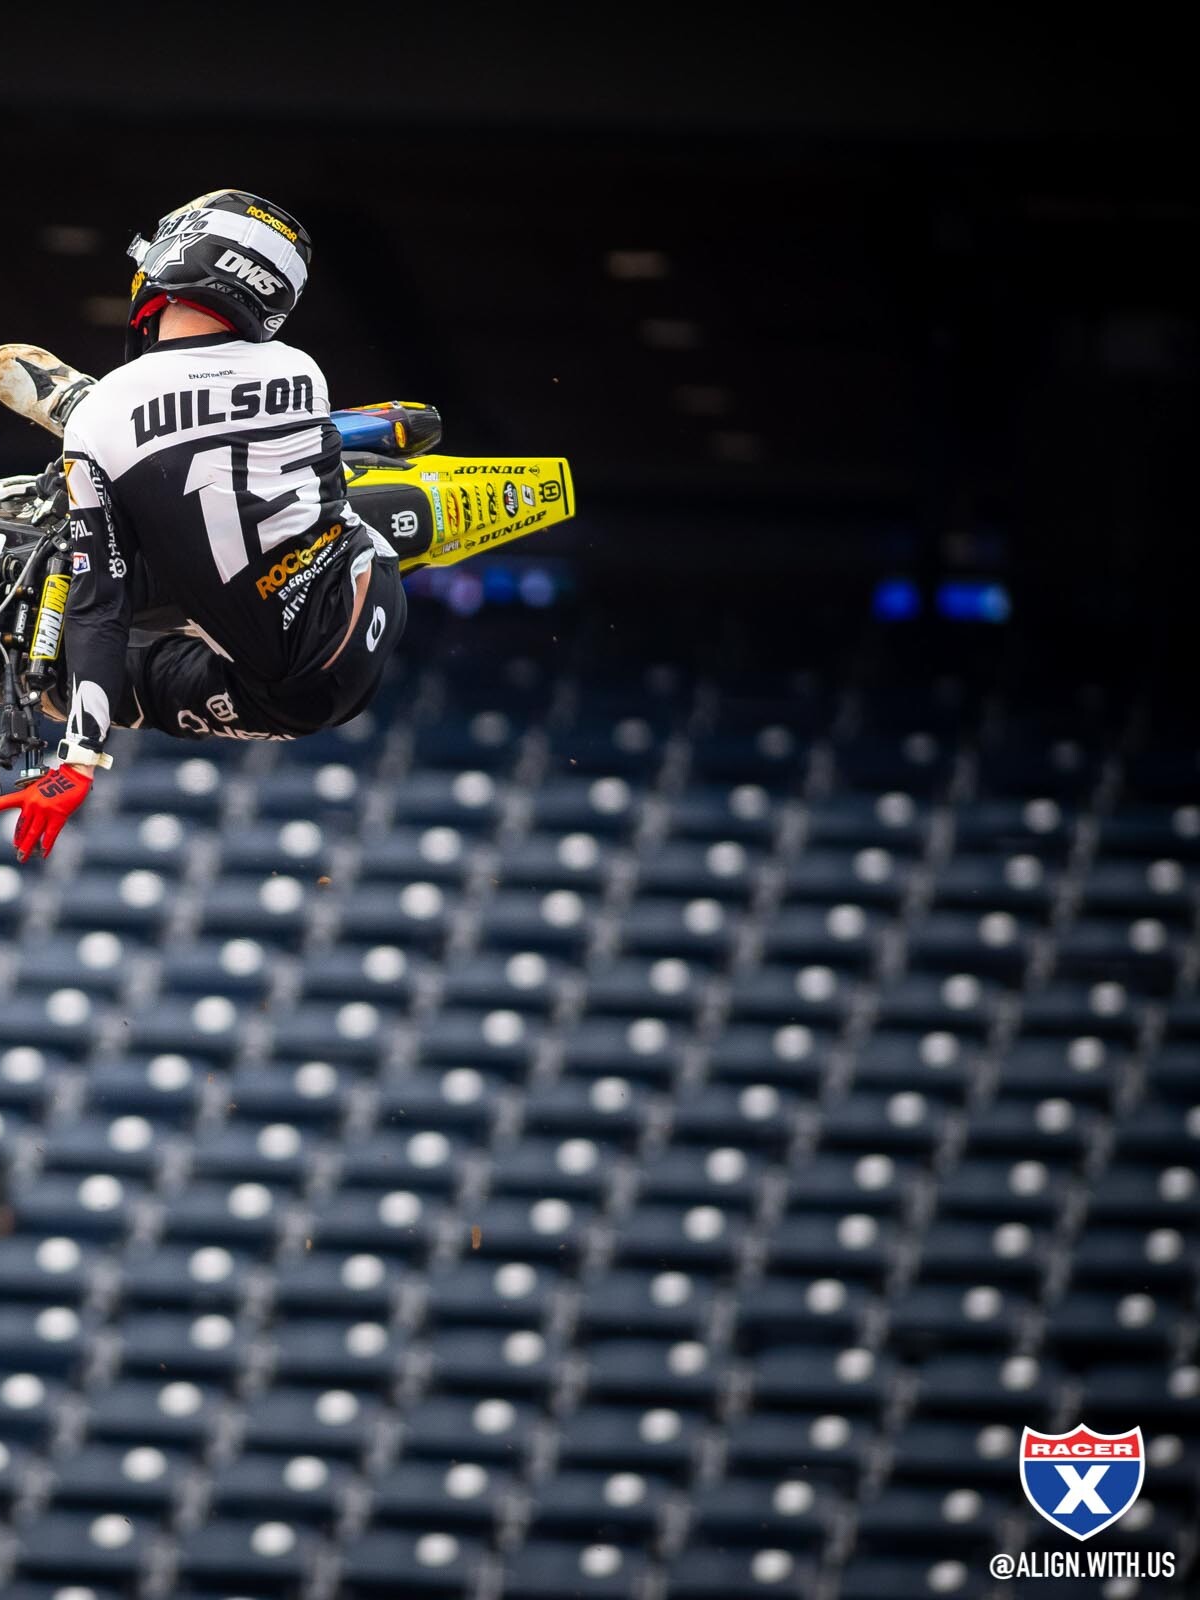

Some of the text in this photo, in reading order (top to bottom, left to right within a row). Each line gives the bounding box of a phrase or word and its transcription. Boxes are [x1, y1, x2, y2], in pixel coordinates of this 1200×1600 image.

[246, 205, 298, 243] ROCKSTAR
[130, 374, 314, 448] WILSON
[453, 465, 526, 475] DUNLOP
[183, 425, 323, 585] 15
[478, 510, 548, 545] DUNLOP
